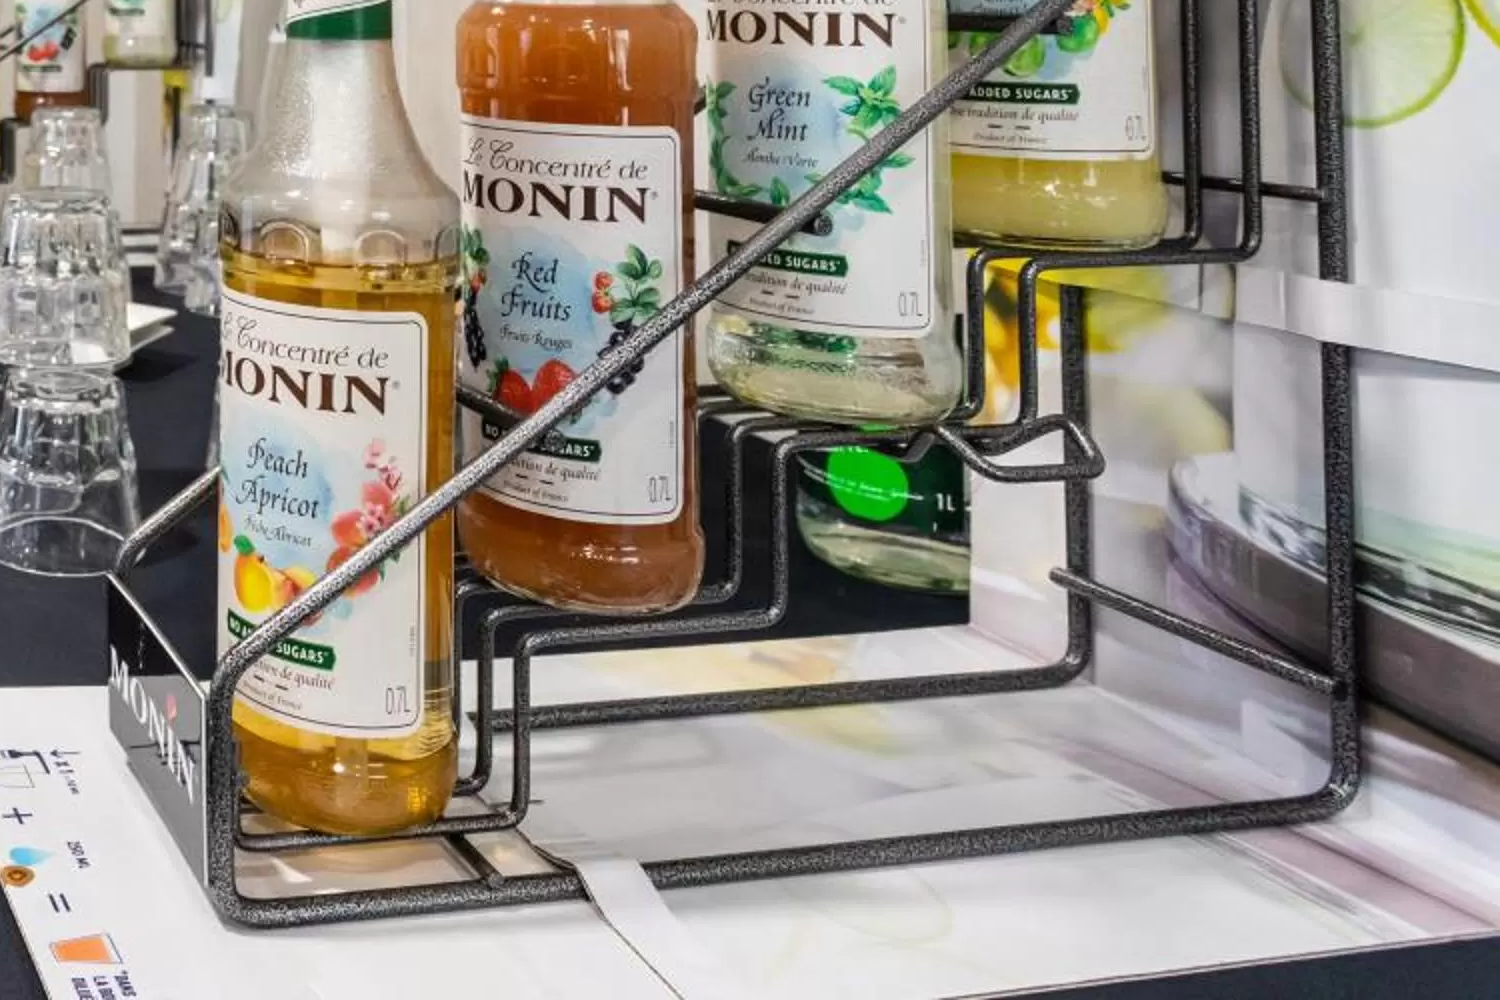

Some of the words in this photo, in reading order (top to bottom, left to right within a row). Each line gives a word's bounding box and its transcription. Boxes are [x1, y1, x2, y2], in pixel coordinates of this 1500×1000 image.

[707, 8, 897, 49] MONIN
[747, 76, 811, 113] Green
[969, 86, 1011, 99] ADDED
[1015, 89, 1072, 101] SUGARS
[745, 107, 809, 141] Mint
[489, 139, 612, 179] Concentré
[619, 160, 649, 180] de
[463, 169, 650, 225] MONIN
[511, 251, 559, 293] Red
[785, 255, 840, 272] SUGARS
[500, 283, 572, 321] Fruits
[237, 315, 350, 368] Concentré
[357, 347, 389, 369] de
[246, 437, 308, 479] Peach
[235, 474, 320, 519] Apricot
[275, 641, 328, 664] SUGARS
[110, 644, 195, 805] MONIN
